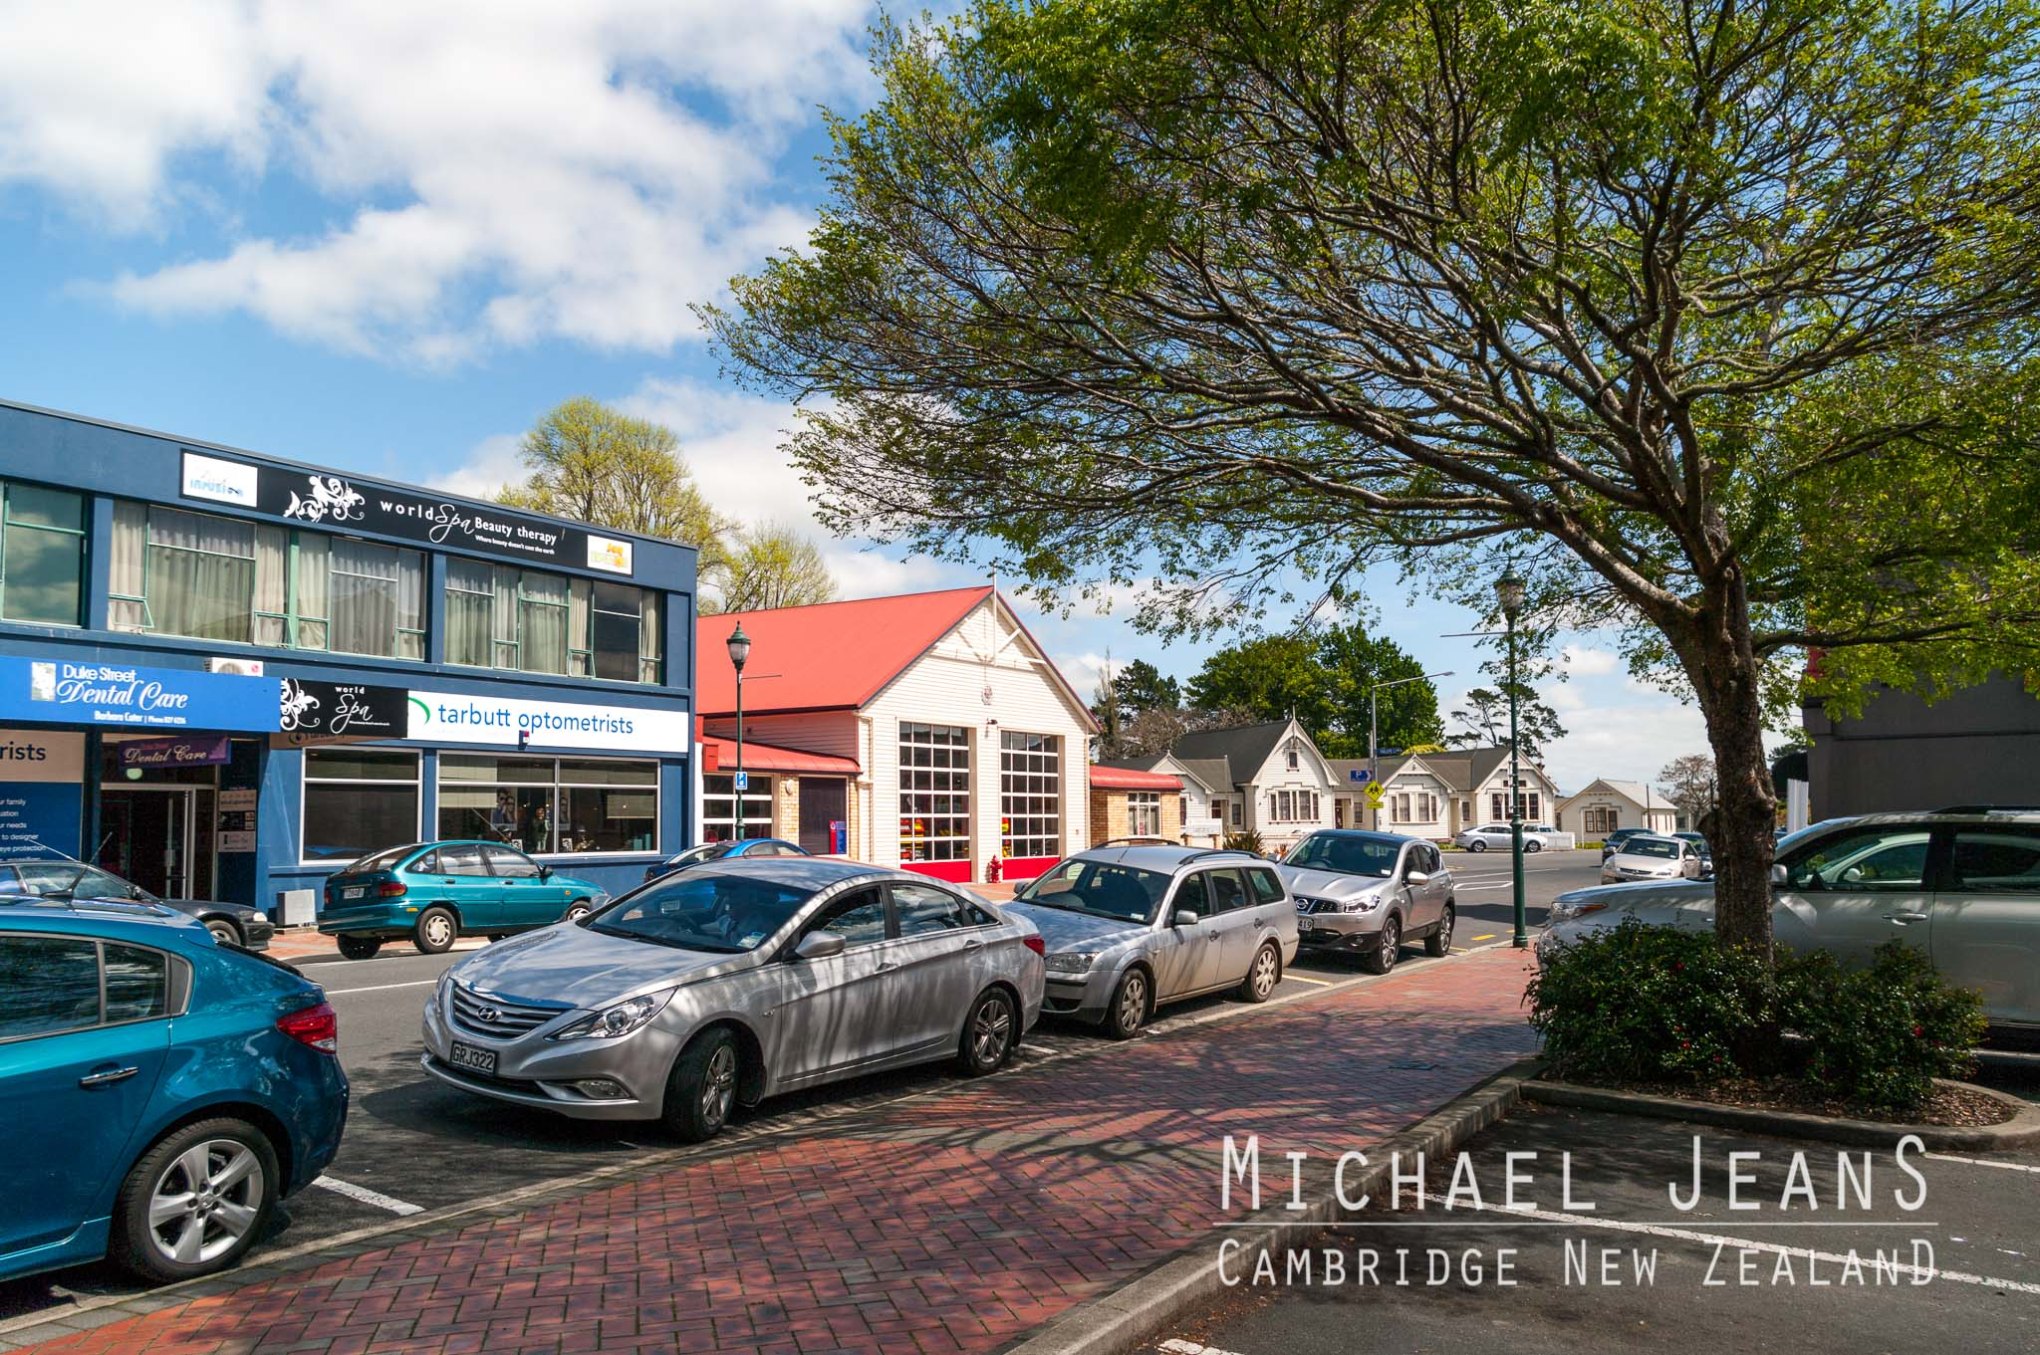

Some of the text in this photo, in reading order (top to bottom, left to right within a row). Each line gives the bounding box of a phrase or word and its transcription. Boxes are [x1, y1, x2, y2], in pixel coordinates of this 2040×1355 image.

[380, 500, 475, 543] world Spa
[475, 516, 557, 546] Beauty therapy
[63, 664, 137, 683] Duke Street
[56, 679, 189, 711] Dental Care
[335, 686, 365, 695] world
[330, 694, 373, 734] Spa
[438, 702, 634, 734] tarbutt optometrists
[124, 748, 172, 763] Dental
[173, 745, 207, 762] Care
[6, 798, 26, 806] family
[10, 833, 40, 842] designer
[453, 1045, 495, 1070] GRJ322
